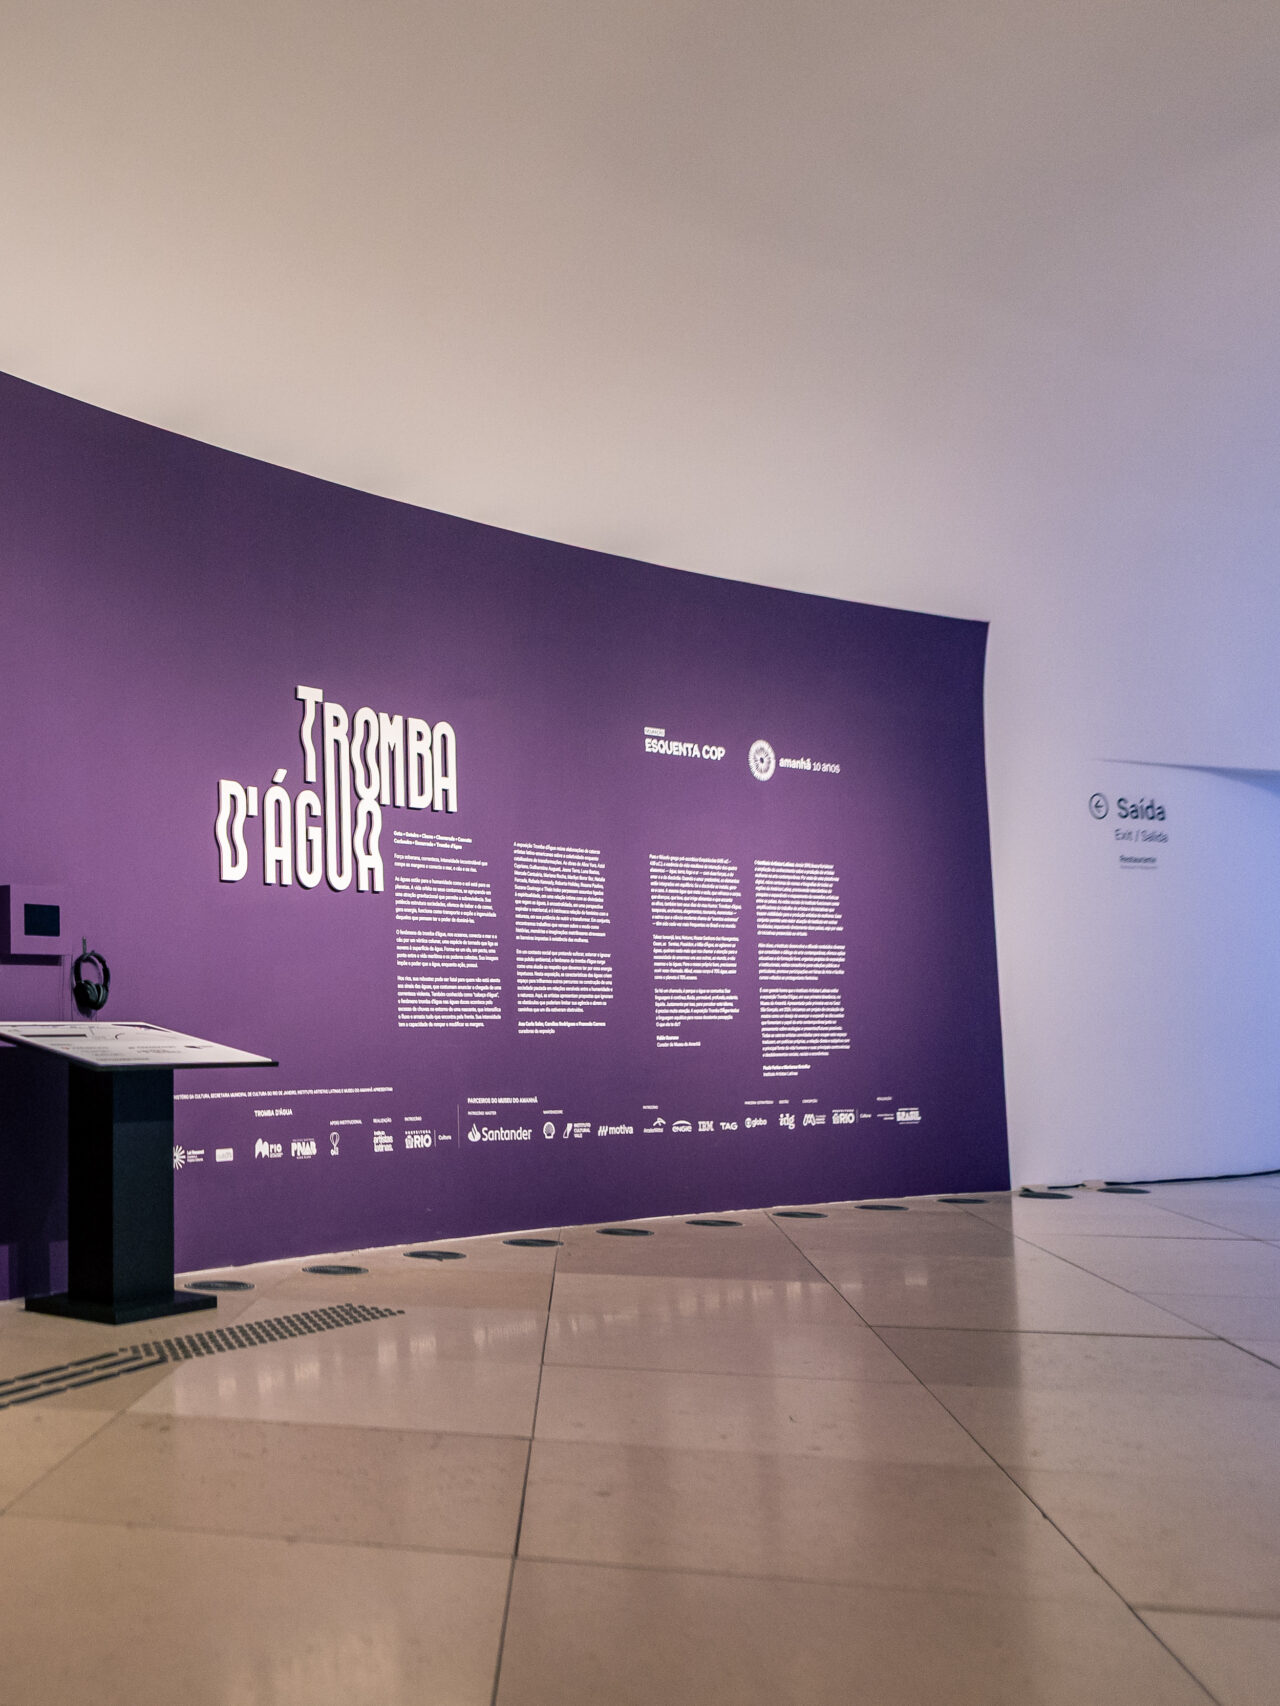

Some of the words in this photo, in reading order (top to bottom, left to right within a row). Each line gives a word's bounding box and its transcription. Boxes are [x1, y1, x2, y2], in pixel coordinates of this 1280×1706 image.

[297, 685, 458, 812] TROMBA
[645, 737, 701, 758] ESQUENTA
[702, 744, 726, 761] COP
[779, 756, 812, 771] amanhã
[812, 762, 821, 772] 10
[821, 763, 841, 774] anos
[1117, 797, 1166, 821] Saída
[216, 768, 384, 891] D'ÁGUA
[254, 1109, 275, 1117] TROMBA
[840, 1112, 855, 1124] RIO
[609, 1124, 634, 1135] motiva
[698, 1120, 715, 1132] IBM
[719, 1122, 738, 1131] TAG
[413, 1134, 432, 1148] RIO
[481, 1126, 532, 1142] Santander
